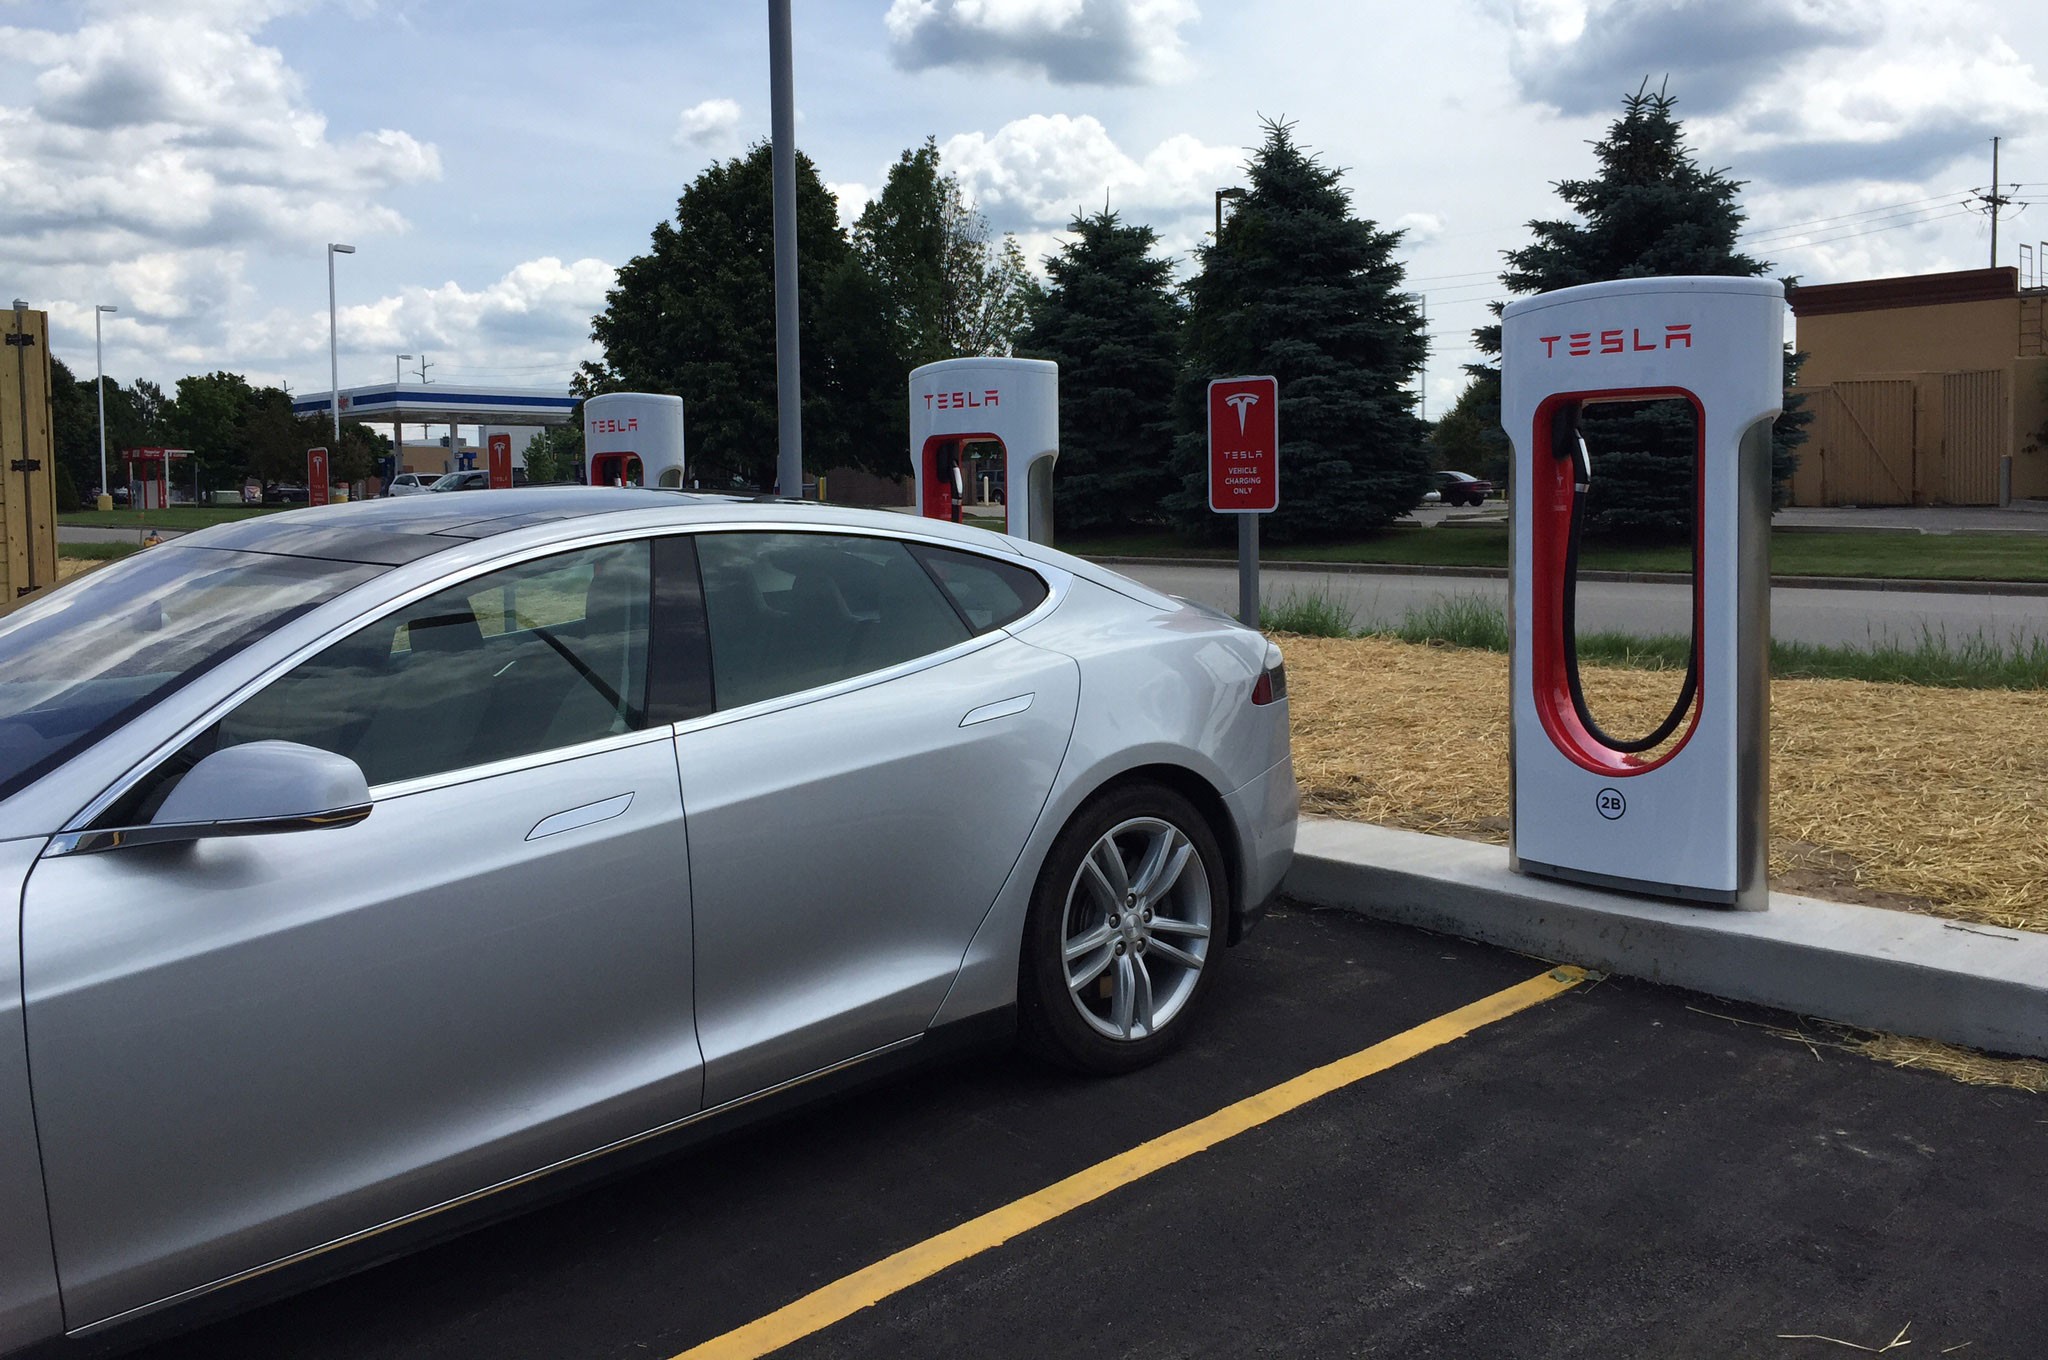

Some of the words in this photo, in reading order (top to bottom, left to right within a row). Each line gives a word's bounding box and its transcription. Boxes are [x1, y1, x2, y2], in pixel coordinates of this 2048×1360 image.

[1539, 323, 1692, 359] TESLA
[924, 390, 1000, 411] TESLA
[591, 417, 638, 434] TESLA
[1224, 450, 1262, 460] TESLA
[1228, 467, 1258, 475] VEHICLE
[1224, 477, 1261, 485] CHARGING
[1233, 487, 1252, 495] ONLY
[1601, 796, 1621, 810] 2B
